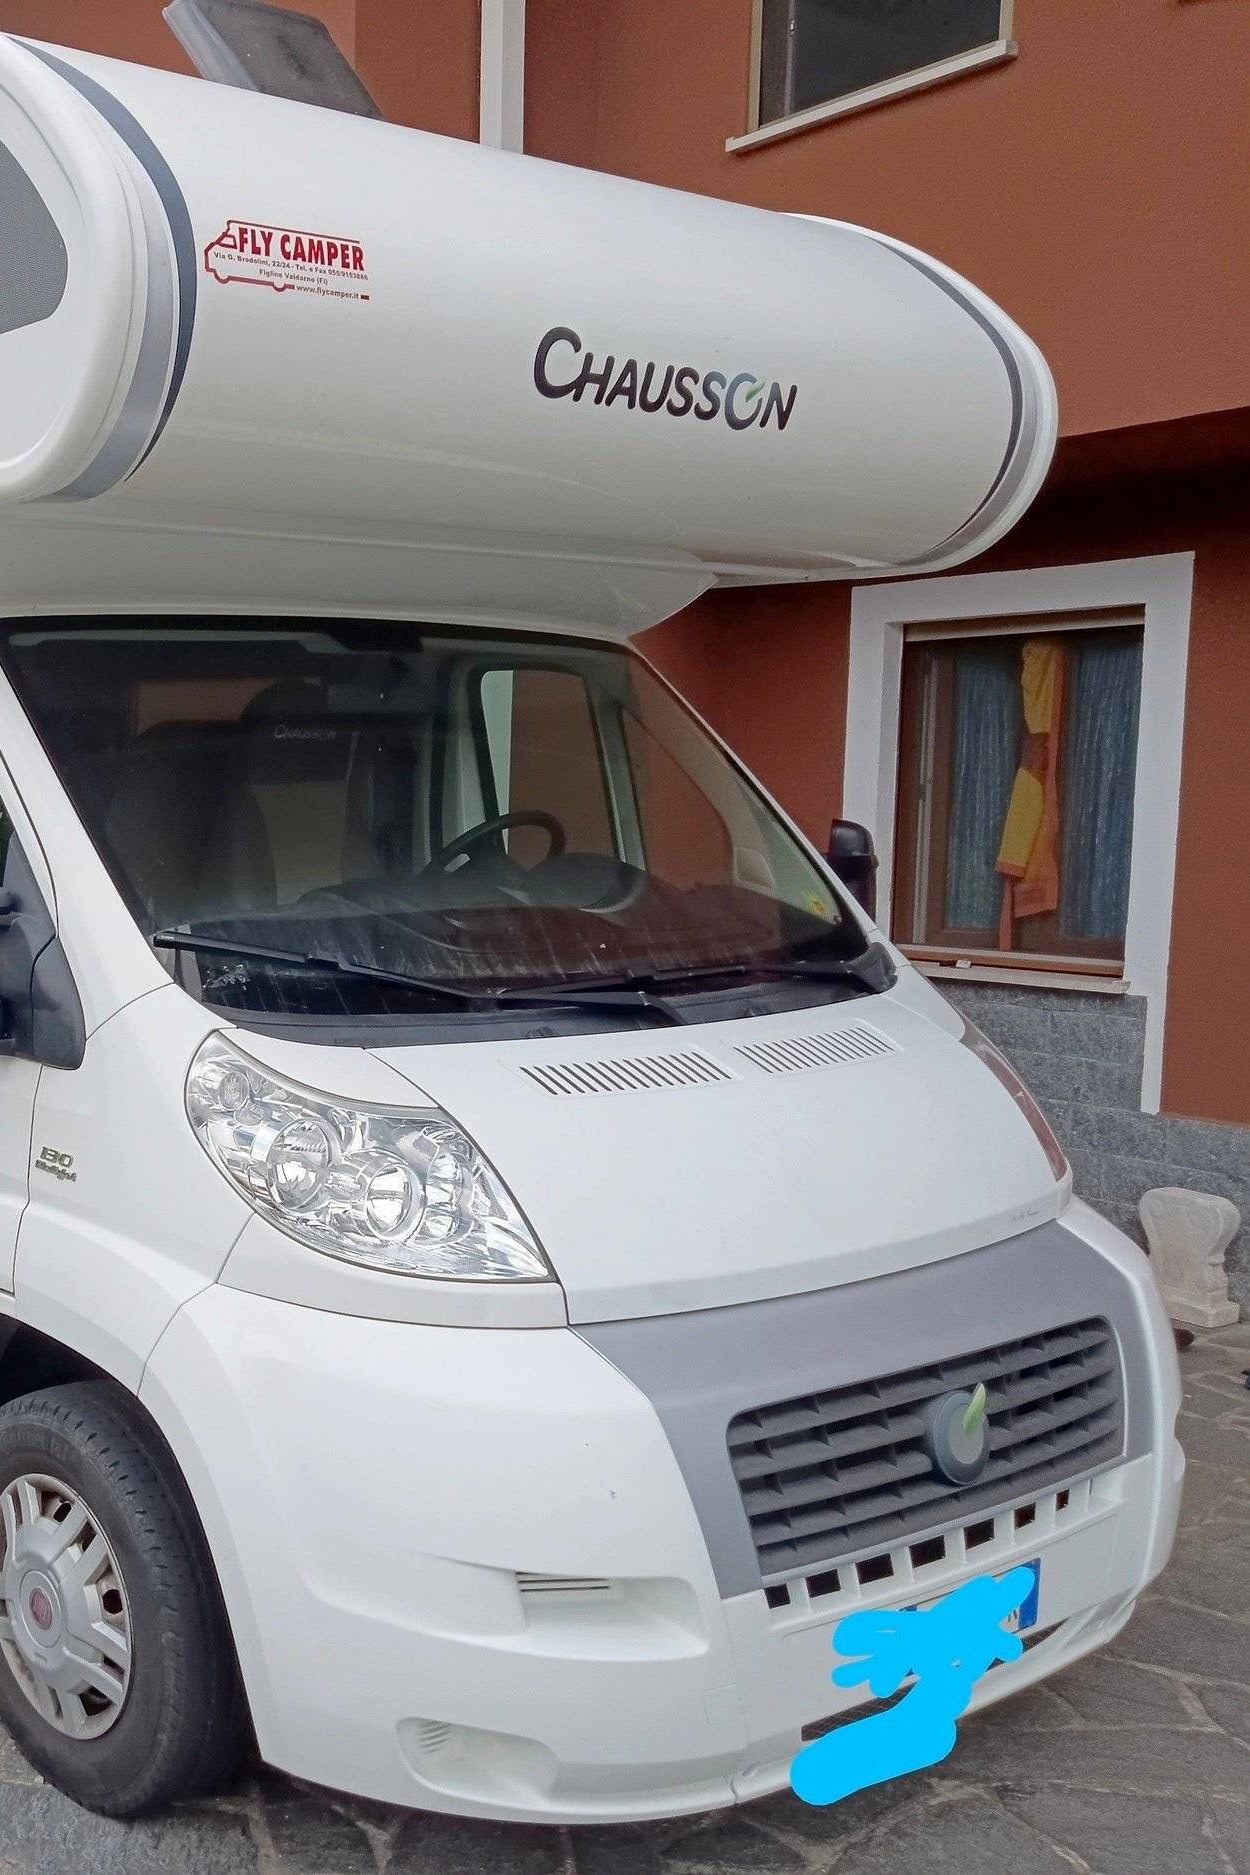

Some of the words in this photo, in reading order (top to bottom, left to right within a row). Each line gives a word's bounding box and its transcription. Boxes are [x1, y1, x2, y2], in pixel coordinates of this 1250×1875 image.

[238, 227, 273, 257] FLY
[280, 234, 364, 271] CAMPER
[259, 269, 283, 278] Figline
[284, 272, 315, 283] Valdarno
[296, 285, 359, 299] www.flycamper.it
[533, 326, 798, 431] CHAUSSON
